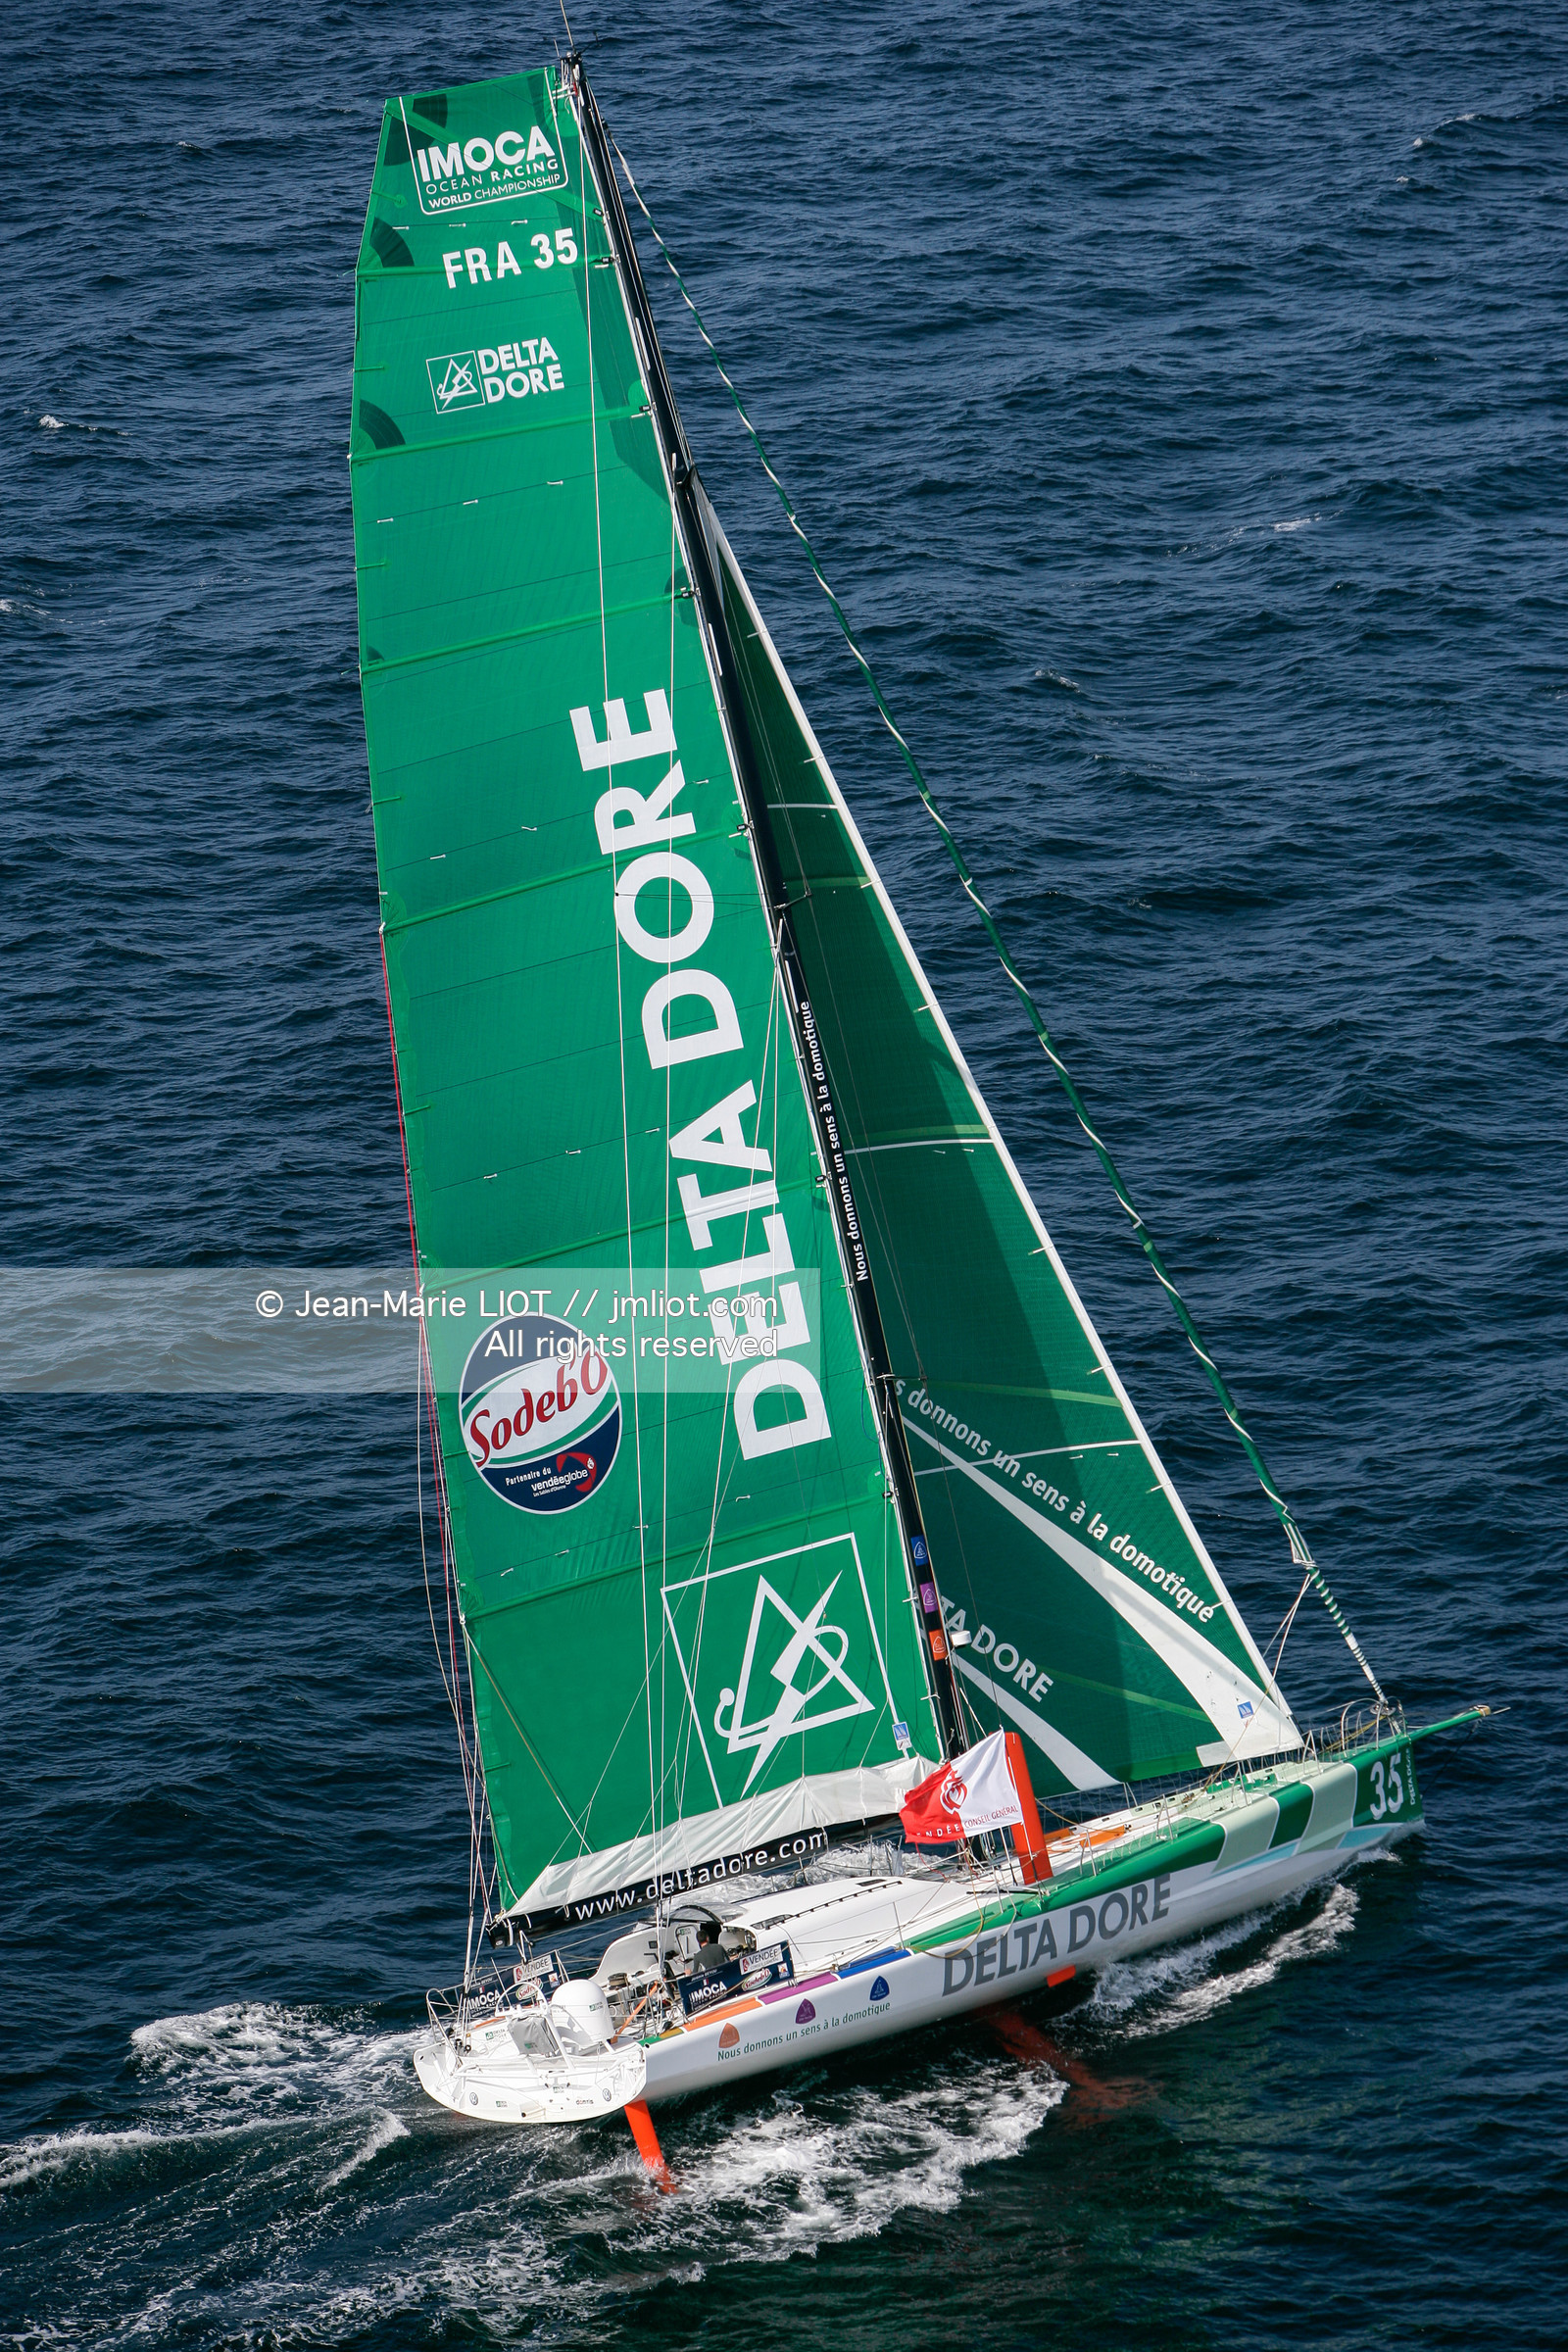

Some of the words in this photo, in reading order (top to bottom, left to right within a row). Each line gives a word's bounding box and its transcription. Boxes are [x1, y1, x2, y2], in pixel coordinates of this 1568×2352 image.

[416, 124, 556, 182] IMOCA
[425, 173, 483, 195] OCEAN
[490, 158, 560, 182] RACING
[428, 192, 472, 209] WORLD
[474, 173, 561, 200] CHAMPIONSHIP
[442, 240, 522, 289] FRA
[530, 227, 579, 270] 35
[477, 336, 560, 375] DELTA
[482, 363, 565, 404] DORE
[568, 689, 745, 1070] DORE
[801, 1001, 825, 1080] domotique
[817, 1083, 829, 1101] la
[819, 1101, 833, 1113] à
[826, 1114, 841, 1150] sens
[834, 1152, 847, 1173] un
[839, 1176, 860, 1240] donnons
[668, 1079, 832, 1462] DELTA
[853, 1244, 868, 1281] Nous
[505, 1470, 541, 1486] Partenaire
[542, 1466, 552, 1476] du
[907, 1388, 991, 1456] donnons
[993, 1449, 1021, 1478] un
[1021, 1472, 1070, 1512] sens
[1069, 1500, 1088, 1524] à
[1087, 1513, 1109, 1541] la
[1109, 1534, 1214, 1623] domotique
[970, 1624, 1054, 1703] DORE
[1369, 1752, 1404, 1821] 35
[964, 1815, 991, 1828] CONSEIL
[574, 1832, 826, 1921] www.deltadore.com
[942, 1918, 1058, 1997] DELTA
[1067, 1873, 1171, 1954] DORE
[691, 1981, 728, 2003] IMOCA
[717, 2048, 741, 2062] Nous
[743, 2035, 784, 2054] donnons
[786, 2030, 798, 2041] un
[800, 2023, 821, 2037] sens
[823, 2019, 830, 2030] à
[831, 2016, 840, 2028] la
[842, 2002, 891, 2025] domotique
